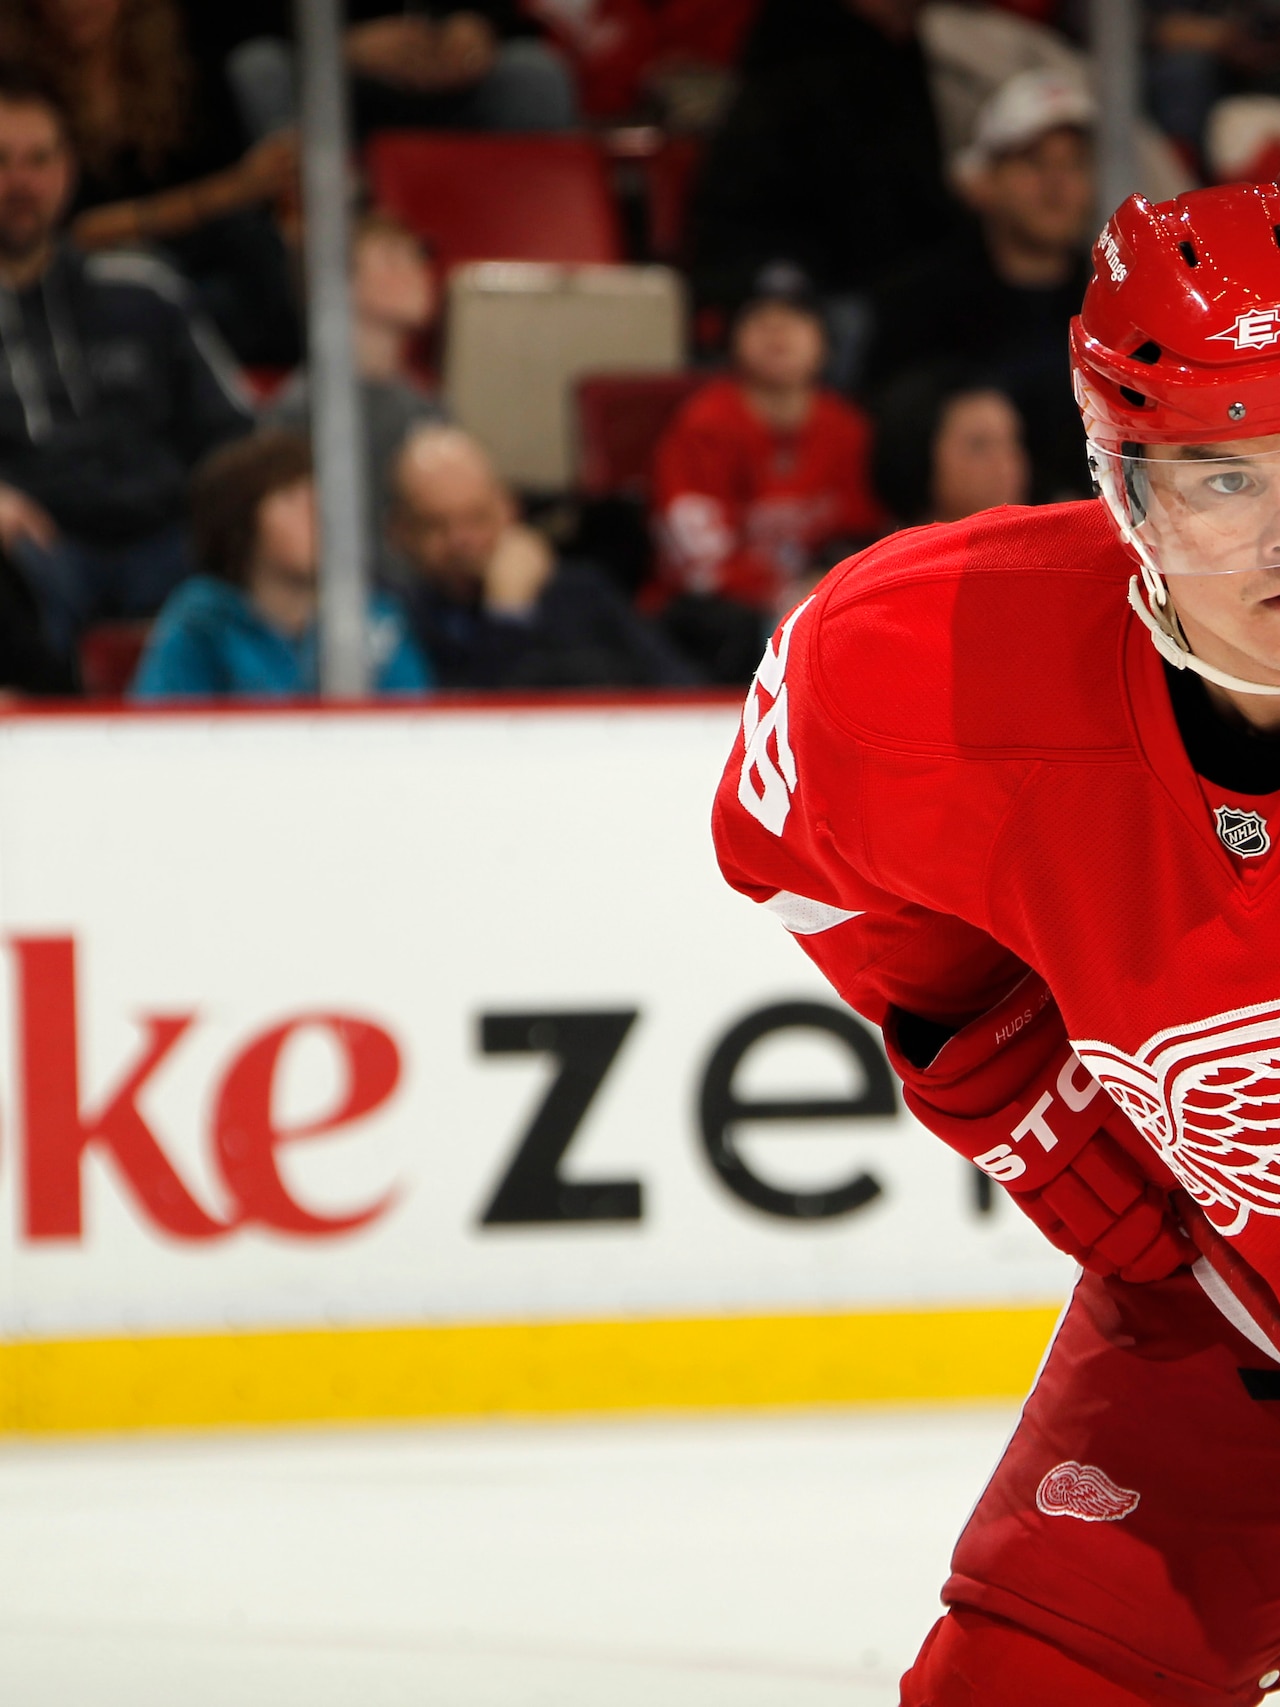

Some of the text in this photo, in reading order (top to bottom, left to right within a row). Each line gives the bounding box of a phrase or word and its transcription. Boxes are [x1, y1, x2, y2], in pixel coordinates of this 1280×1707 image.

[1104, 238, 1127, 282] Wings
[1238, 313, 1275, 346] E
[1228, 822, 1257, 844] NHL
[995, 1009, 1033, 1045] HUDS
[477, 998, 993, 1228] ze
